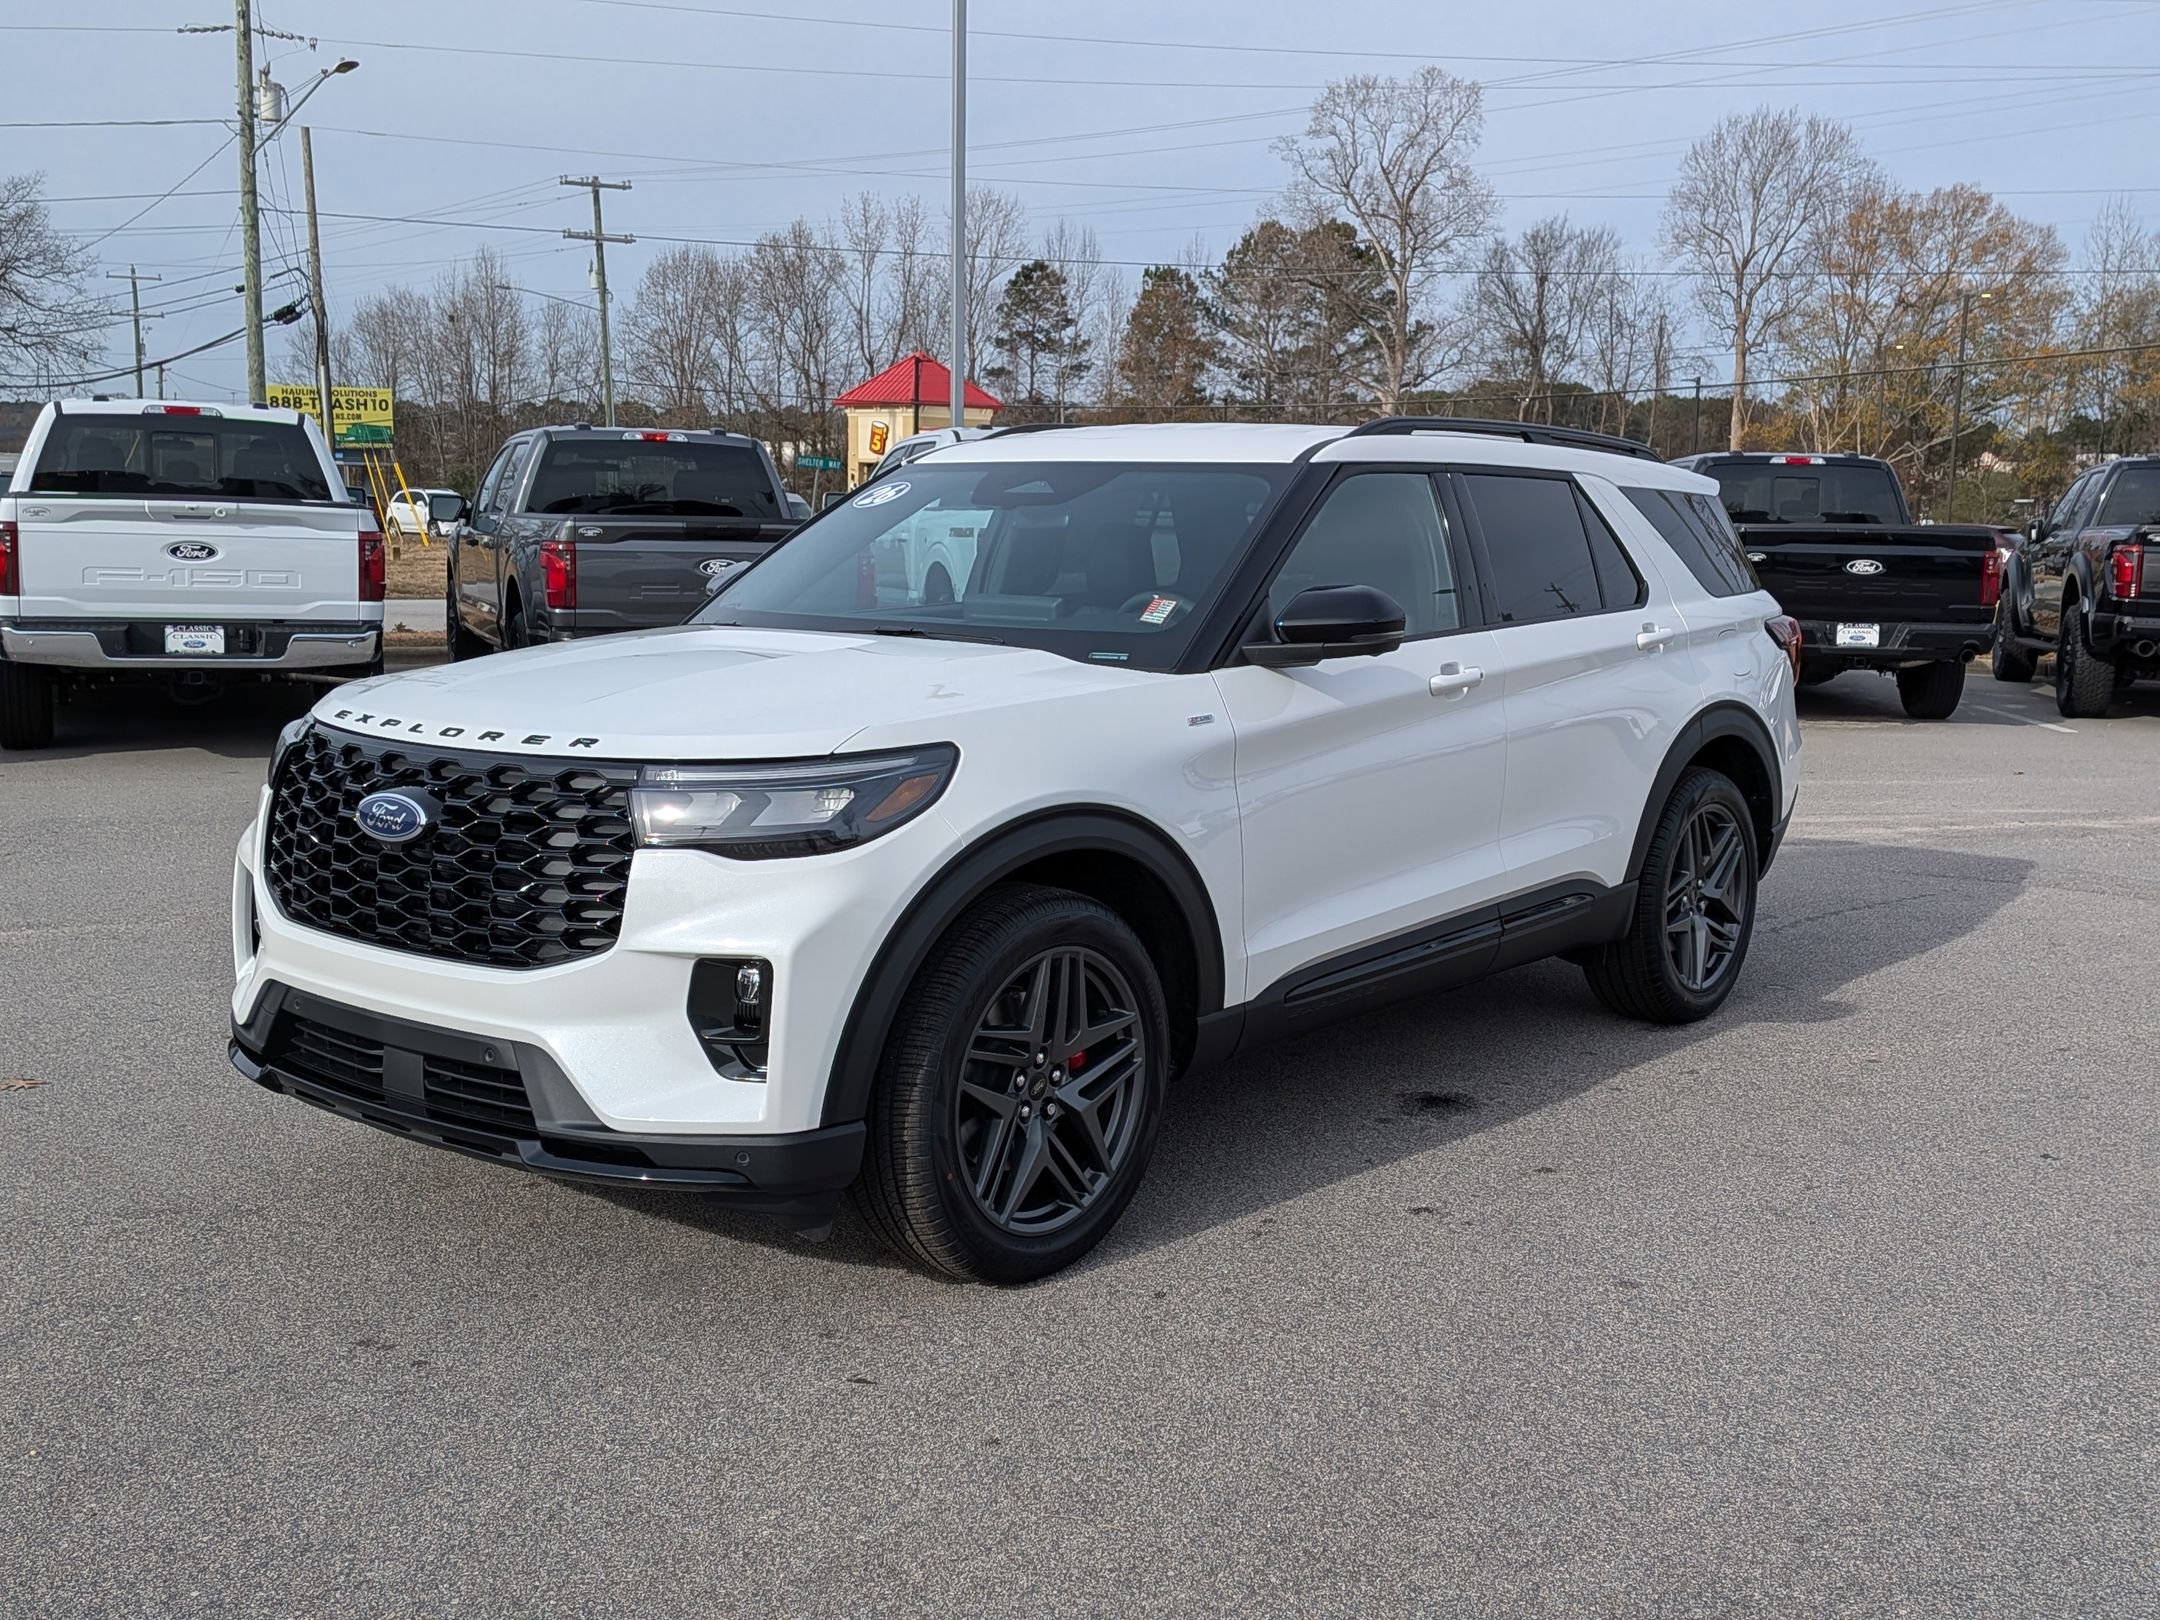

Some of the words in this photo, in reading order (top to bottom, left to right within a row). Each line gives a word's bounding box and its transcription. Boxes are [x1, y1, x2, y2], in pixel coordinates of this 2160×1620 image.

[281, 387, 319, 396] HAULIN
[331, 389, 378, 398] OLUTIONS
[269, 395, 389, 412] 888-TASH10
[871, 434, 881, 451] 5
[797, 457, 824, 468] SHELTER
[828, 460, 841, 469] WAY
[176, 545, 209, 557] Ford
[1852, 562, 1876, 571] Ford
[82, 566, 302, 588] F-150
[334, 710, 600, 748] EXPLORER
[367, 801, 407, 831] Ford
